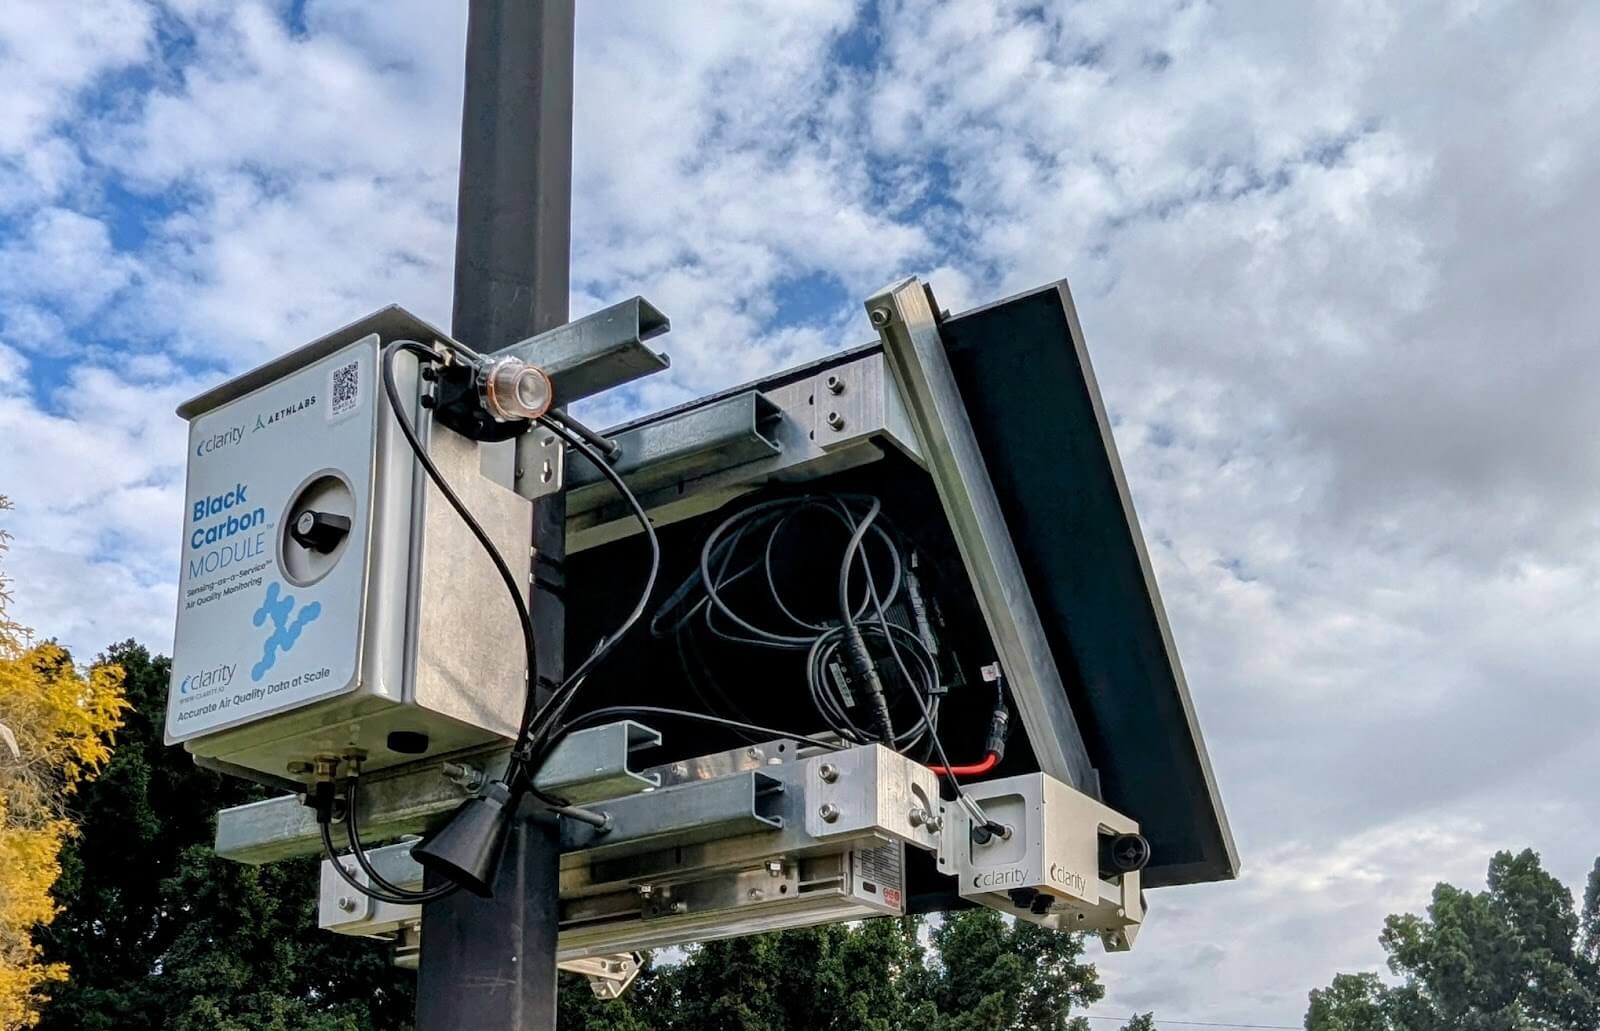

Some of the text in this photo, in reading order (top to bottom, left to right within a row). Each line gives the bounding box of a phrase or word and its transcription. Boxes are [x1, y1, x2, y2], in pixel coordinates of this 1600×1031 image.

[267, 395, 316, 425] AETHLABS
[205, 425, 246, 453] clarity
[192, 482, 248, 523] Black
[191, 506, 265, 550] Carbon
[185, 577, 263, 611] Air Quality Monitoring
[190, 663, 237, 691] clarity
[176, 667, 330, 722] Accurate Air Quality Data at Scale
[983, 867, 1029, 887] clarity
[1057, 866, 1086, 897] clarity
